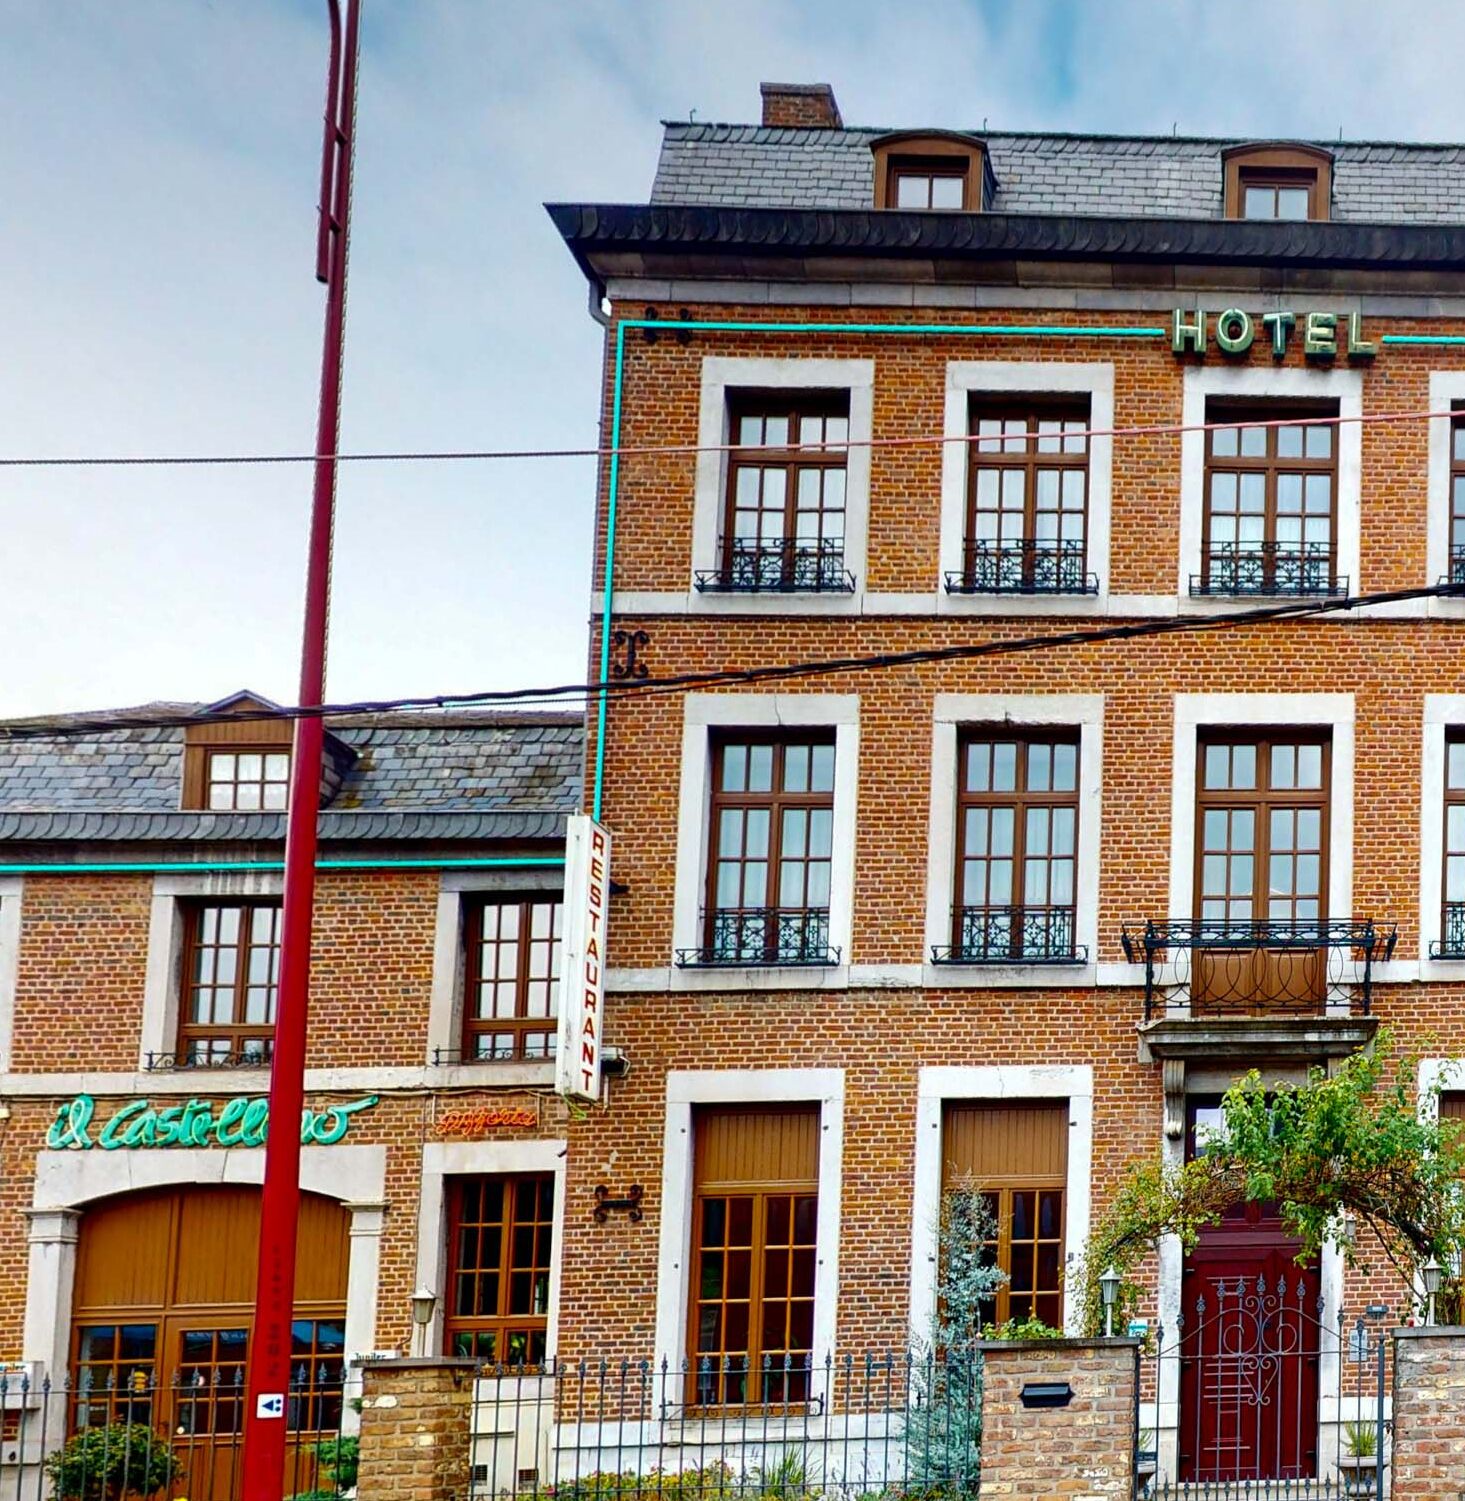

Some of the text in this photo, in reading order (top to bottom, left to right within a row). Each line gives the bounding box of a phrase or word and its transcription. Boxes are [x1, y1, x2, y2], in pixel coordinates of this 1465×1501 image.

[1172, 308, 1379, 361] HOTEL
[580, 831, 604, 1091] RESTAURANT
[100, 1095, 379, 1150] Castello
